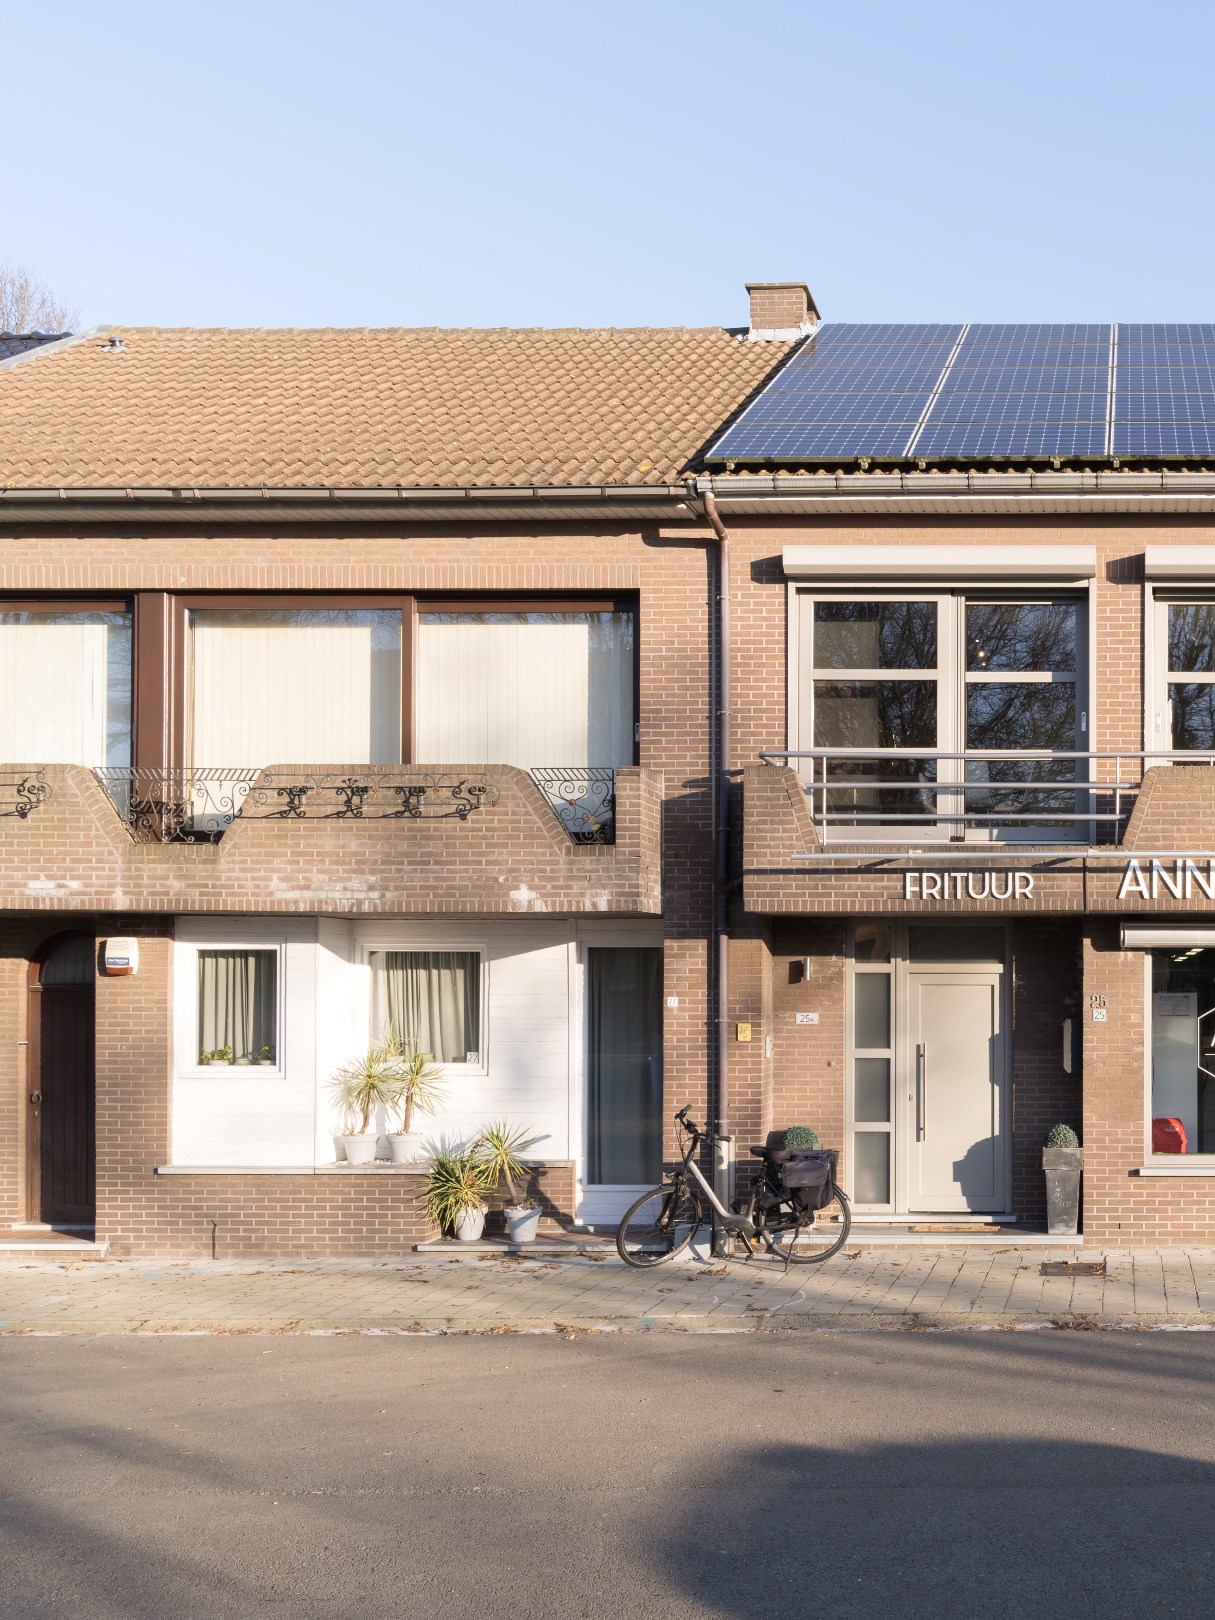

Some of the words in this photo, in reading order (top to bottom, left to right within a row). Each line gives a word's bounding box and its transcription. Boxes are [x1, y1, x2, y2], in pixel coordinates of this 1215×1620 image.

[905, 872, 1035, 900] FRITUUR
[1090, 994, 1107, 1009] 25
[1094, 1010, 1105, 1020] 25
